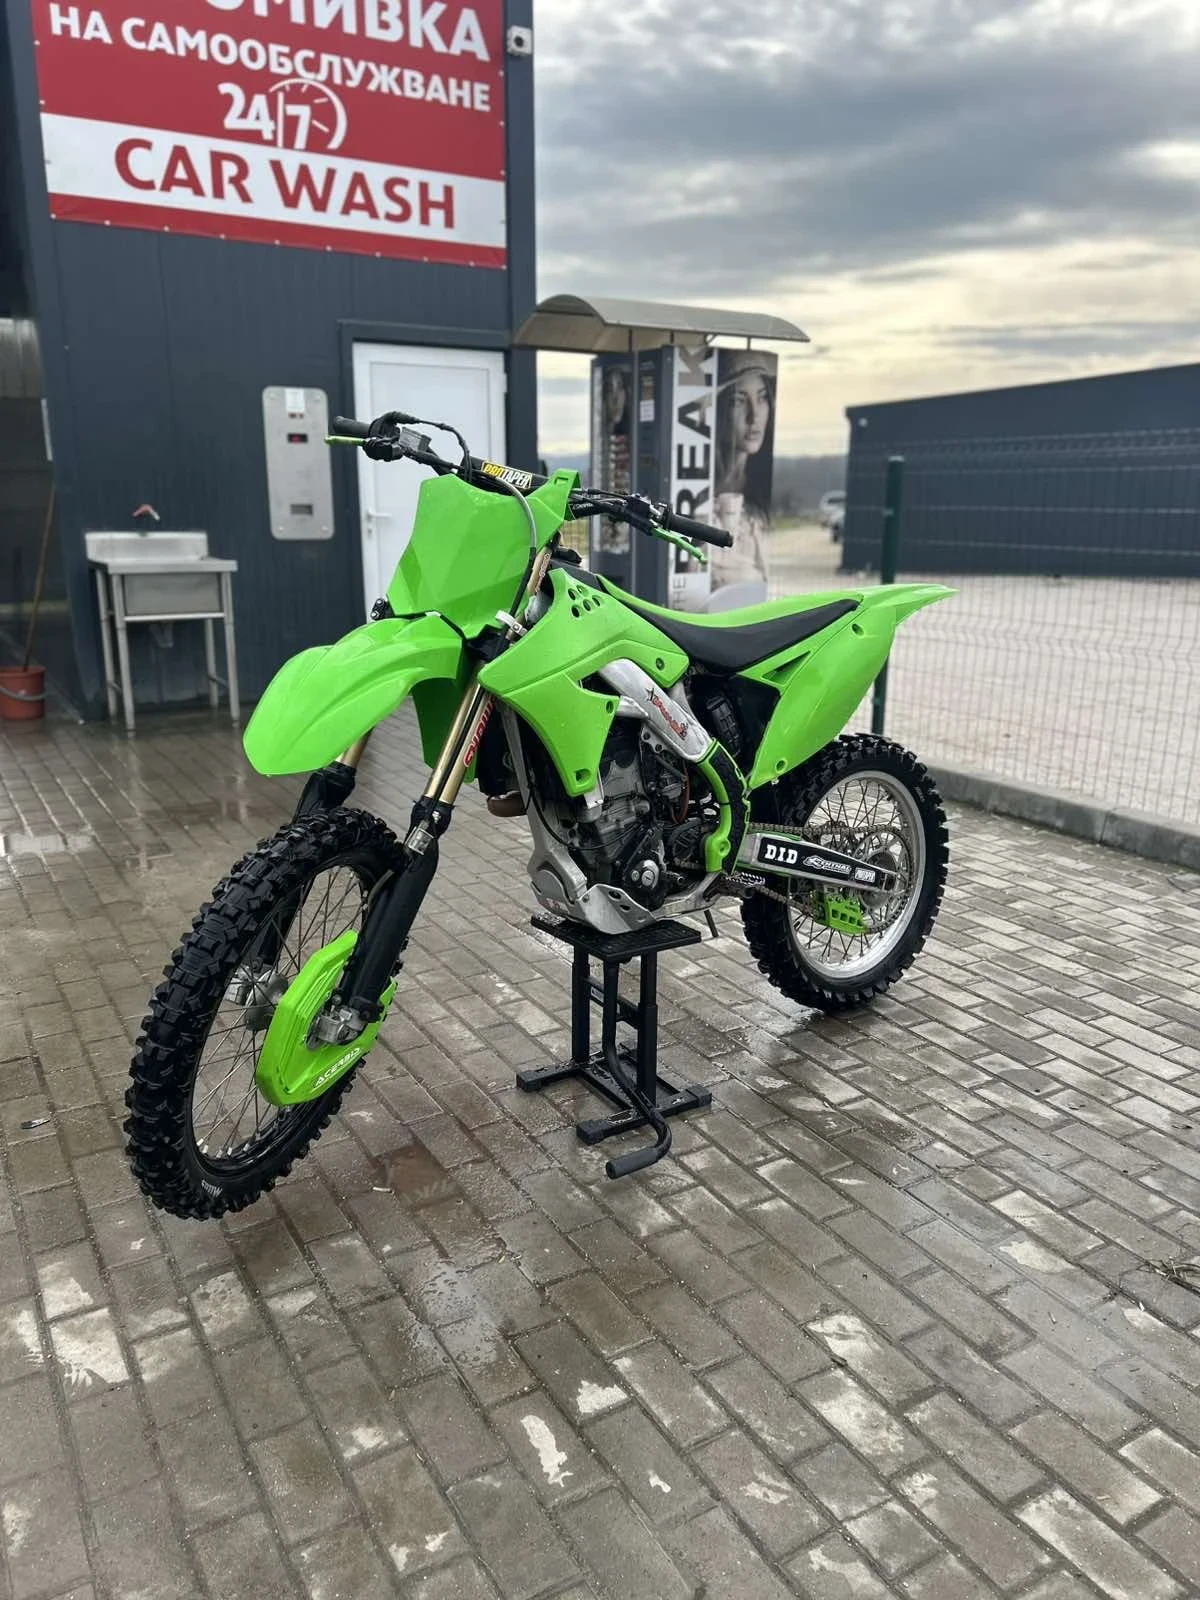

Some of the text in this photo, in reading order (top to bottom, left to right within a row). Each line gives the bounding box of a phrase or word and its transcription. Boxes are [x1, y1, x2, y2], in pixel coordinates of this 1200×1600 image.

[49, 2, 491, 112] НА САМООБСЛУЖВАНЕ
[114, 138, 456, 230] CAR WASH
